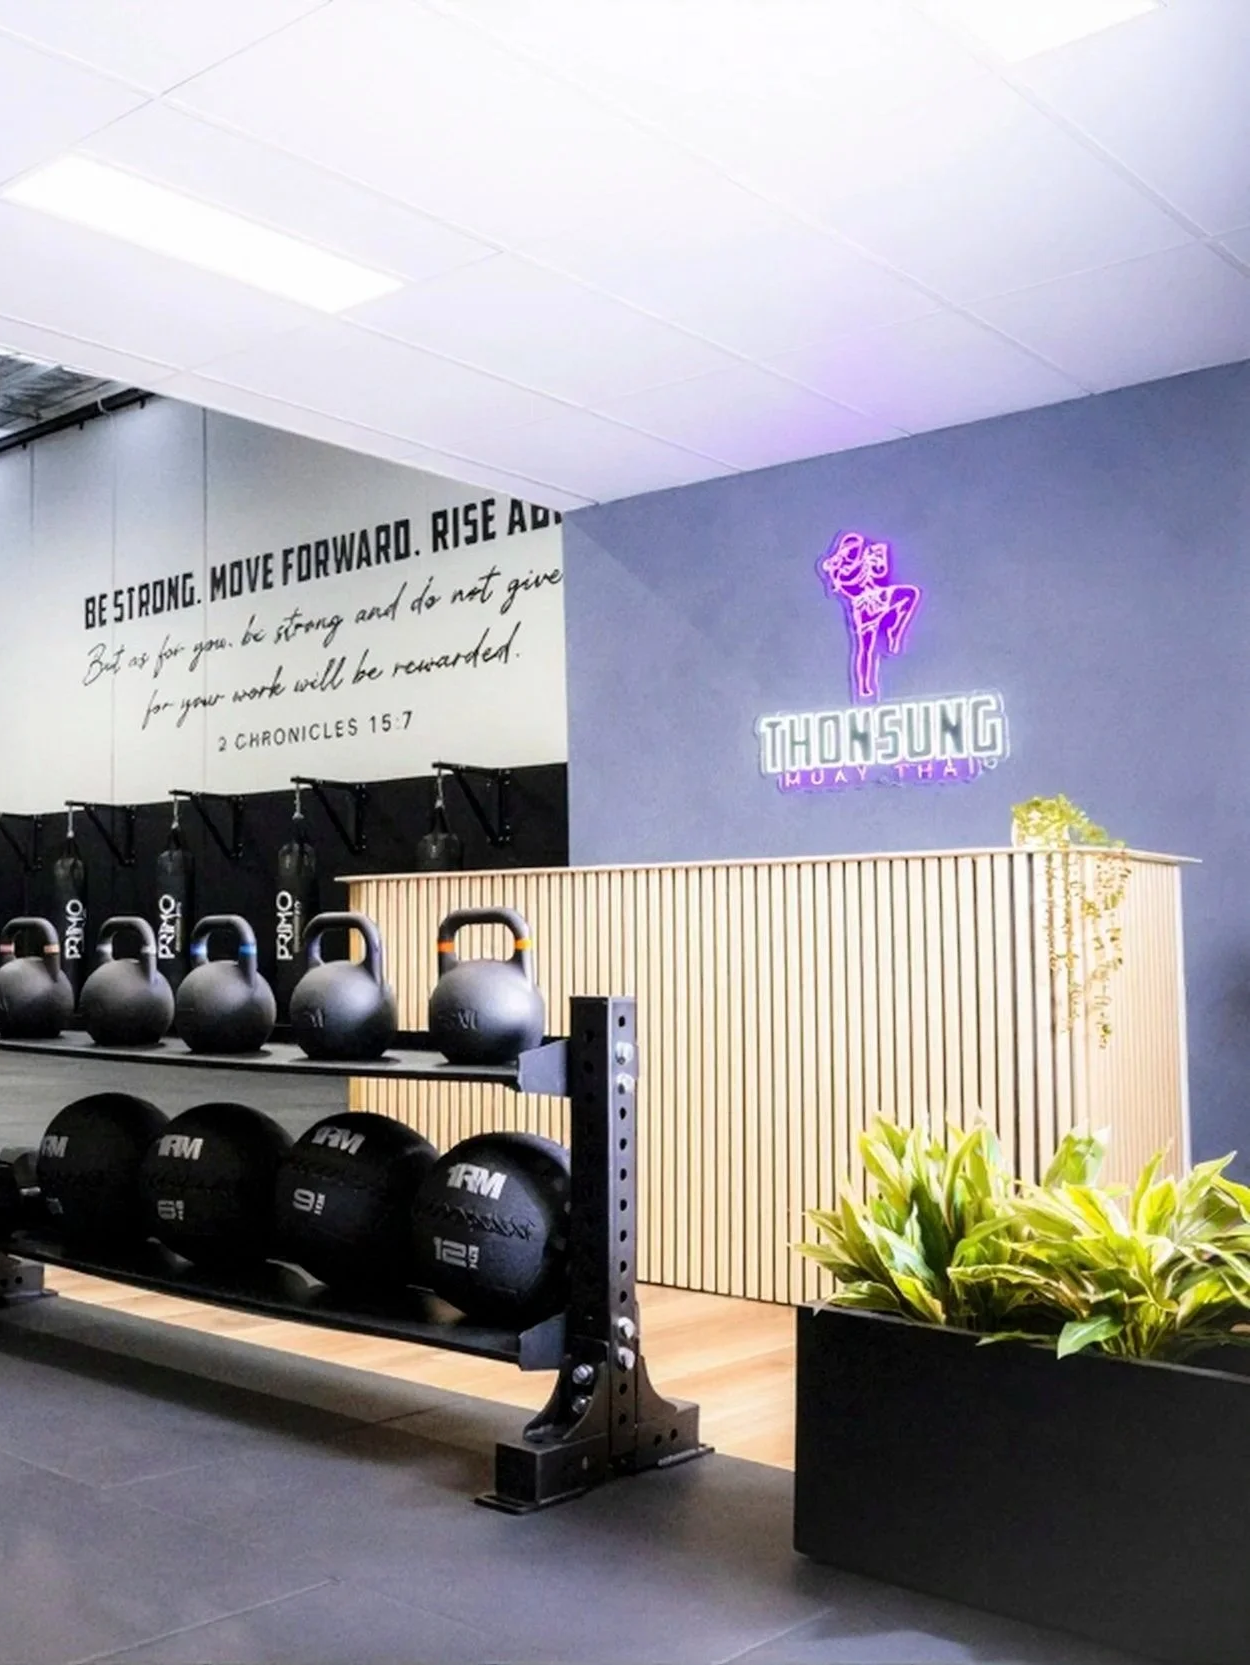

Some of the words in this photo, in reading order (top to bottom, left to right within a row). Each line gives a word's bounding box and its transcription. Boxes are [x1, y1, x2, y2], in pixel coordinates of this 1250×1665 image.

[85, 593, 108, 630] BE
[113, 571, 202, 622] STRONG.
[210, 553, 273, 602] MOVE
[282, 518, 420, 586] FORWARD.
[432, 498, 496, 552] RISE
[82, 643, 125, 686] But
[128, 652, 149, 669] as
[153, 634, 185, 678] for
[241, 614, 267, 646] be
[274, 607, 344, 648] strong
[354, 581, 407, 624] and
[410, 576, 441, 614] do
[451, 565, 501, 604] not
[500, 568, 563, 615] give
[141, 689, 173, 730] for
[176, 694, 225, 728] your
[232, 665, 286, 702] work
[293, 656, 346, 692] will
[352, 648, 383, 684] be
[391, 621, 521, 677] rewarded.
[218, 736, 227, 752] 2
[234, 717, 358, 750] CHRONICLES
[369, 710, 413, 733] 15:7
[759, 693, 1002, 773] THONSUNG
[785, 765, 869, 787] MUAY
[895, 756, 975, 778] THAI
[65, 899, 83, 960] PRIMO
[158, 894, 176, 959] PRIMO
[276, 890, 293, 960] PRIMO
[157, 1134, 203, 1160] 1RM
[312, 1126, 366, 1155] 1RM
[446, 1162, 507, 1200] 1RM
